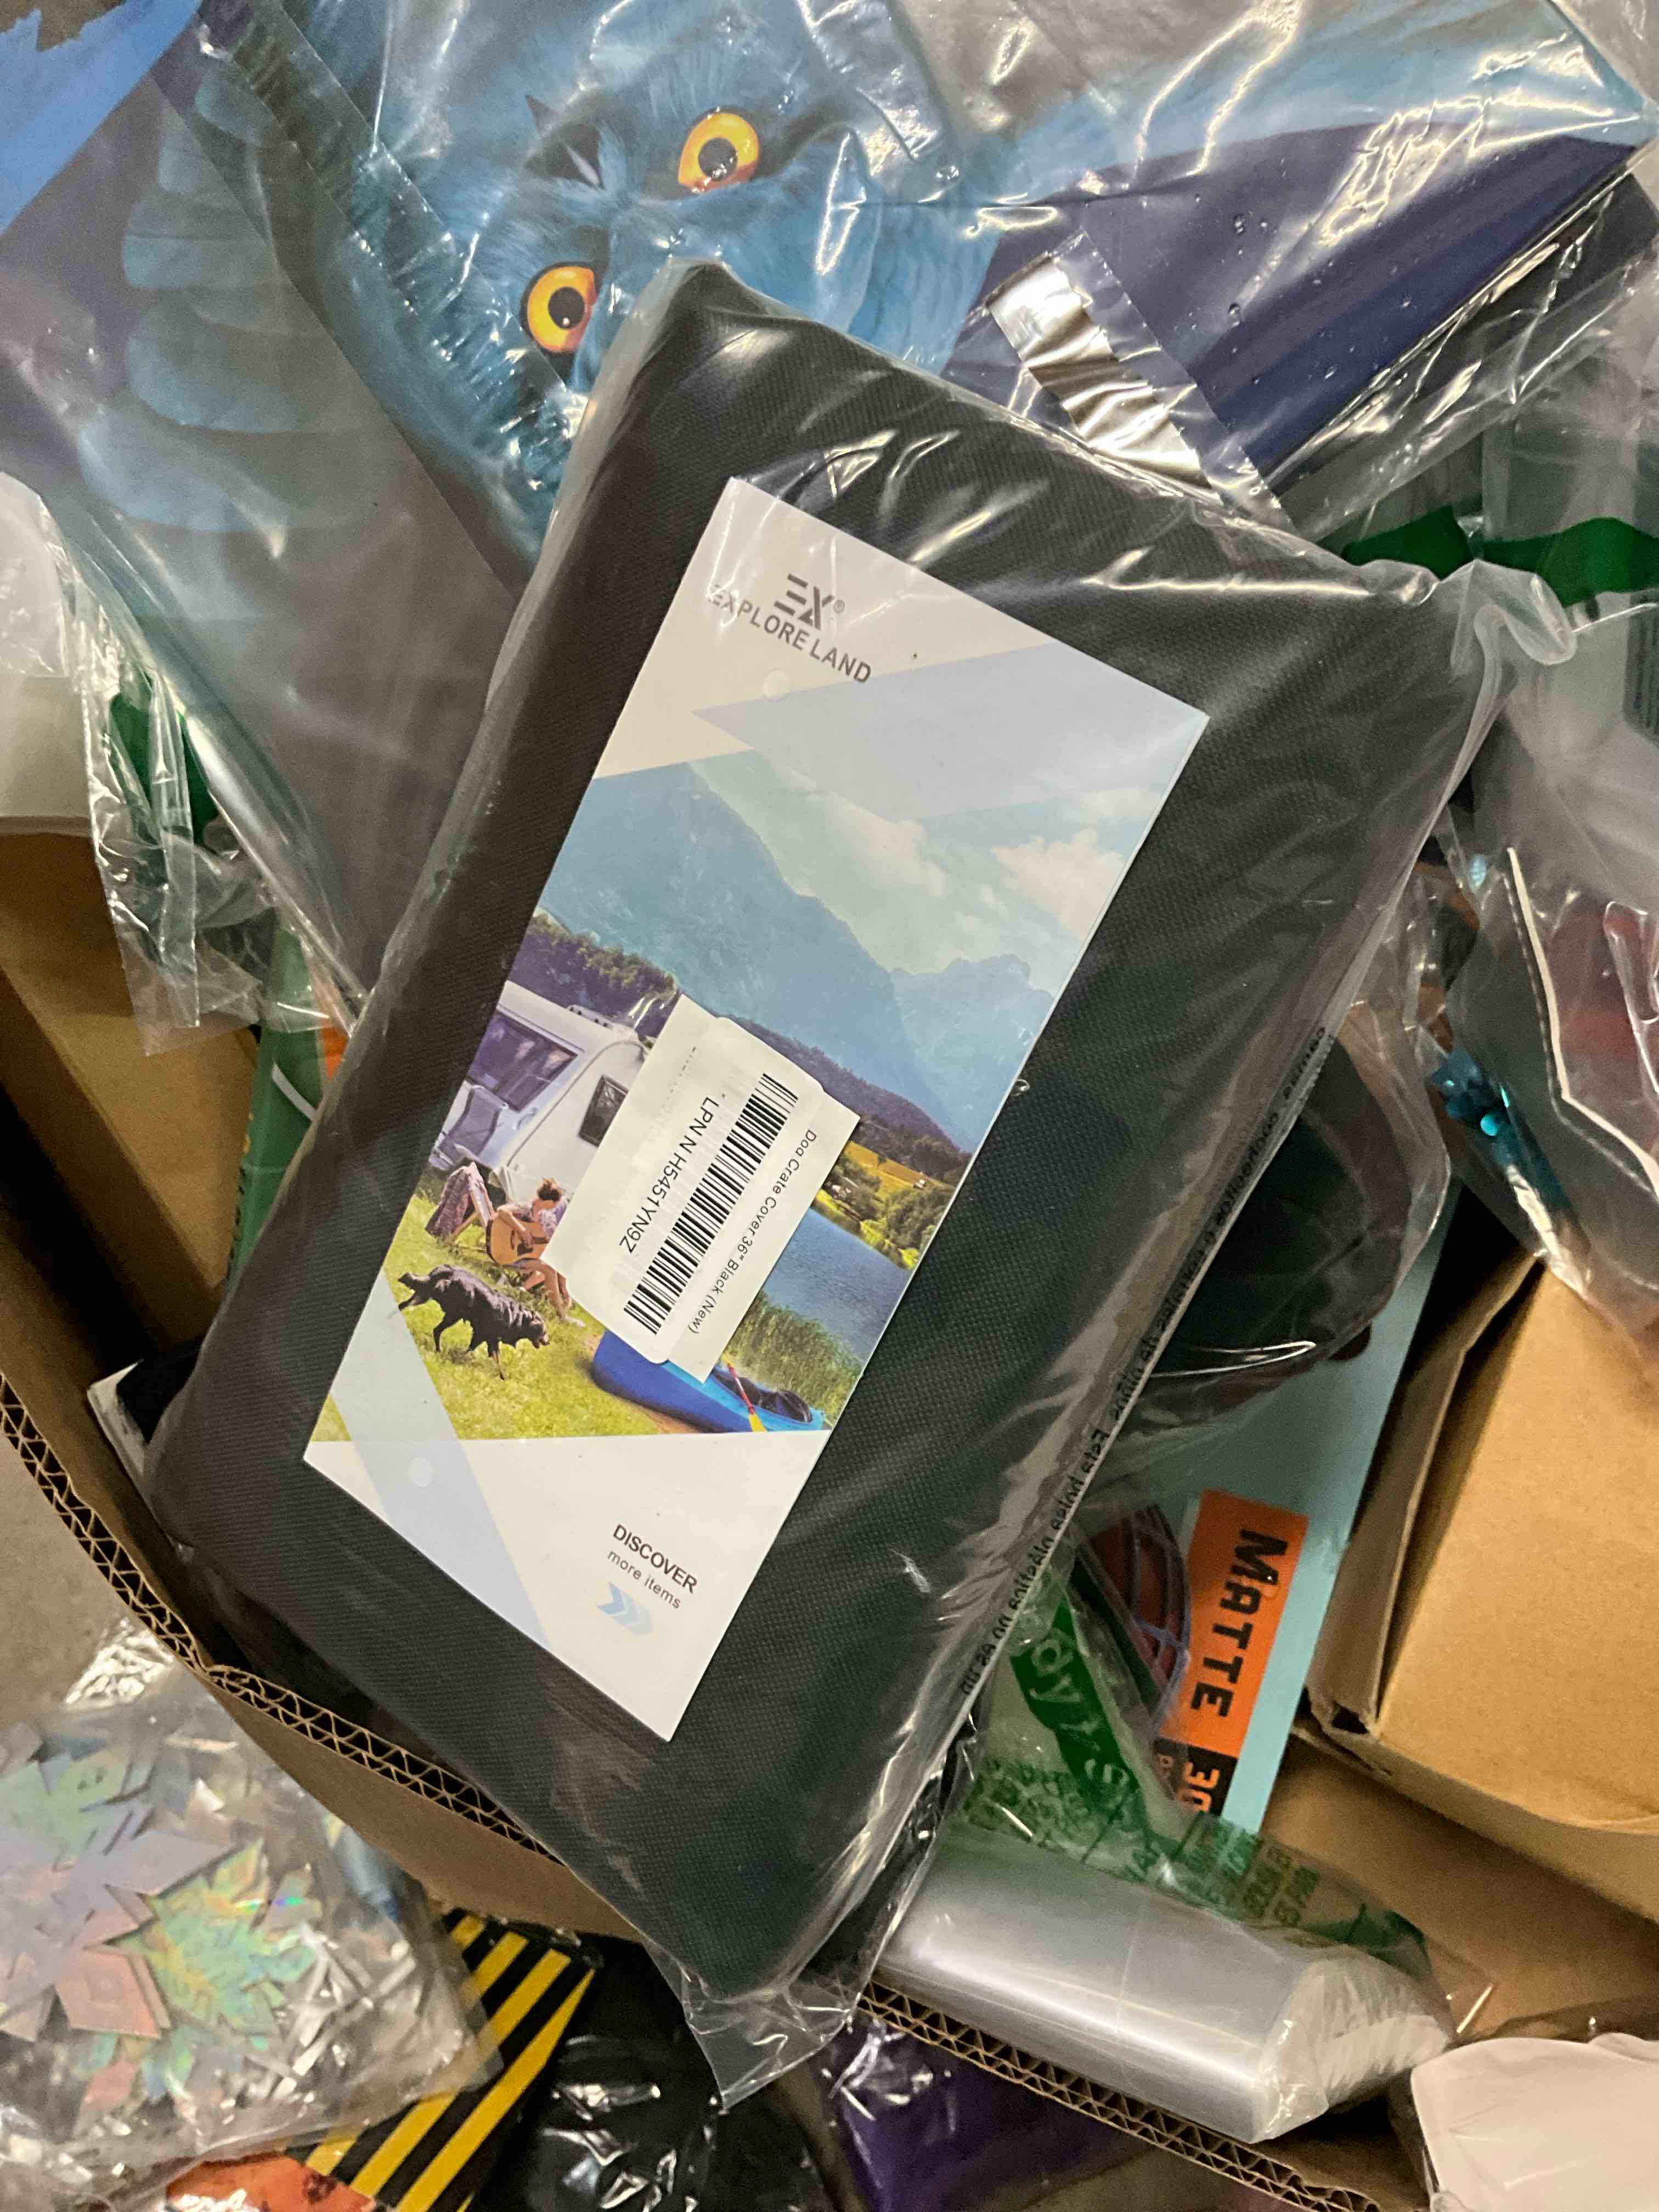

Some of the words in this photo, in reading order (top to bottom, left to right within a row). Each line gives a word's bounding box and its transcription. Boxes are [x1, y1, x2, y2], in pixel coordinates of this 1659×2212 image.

[710, 584, 811, 651] EXPLORE
[809, 639, 872, 684] LAND
[689, 1097, 720, 1137] LPN
[679, 1135, 697, 1154] N
[772, 1158, 800, 1195] Crate
[619, 1152, 687, 1254] H5451YN9Z
[751, 1197, 777, 1237] Cover
[737, 1236, 753, 1261] 36"
[712, 1259, 739, 1296] Black
[688, 1295, 717, 1334] (New)
[613, 1523, 698, 1594] DISCOVER
[607, 1551, 642, 1580] more
[644, 1575, 681, 1610] items
